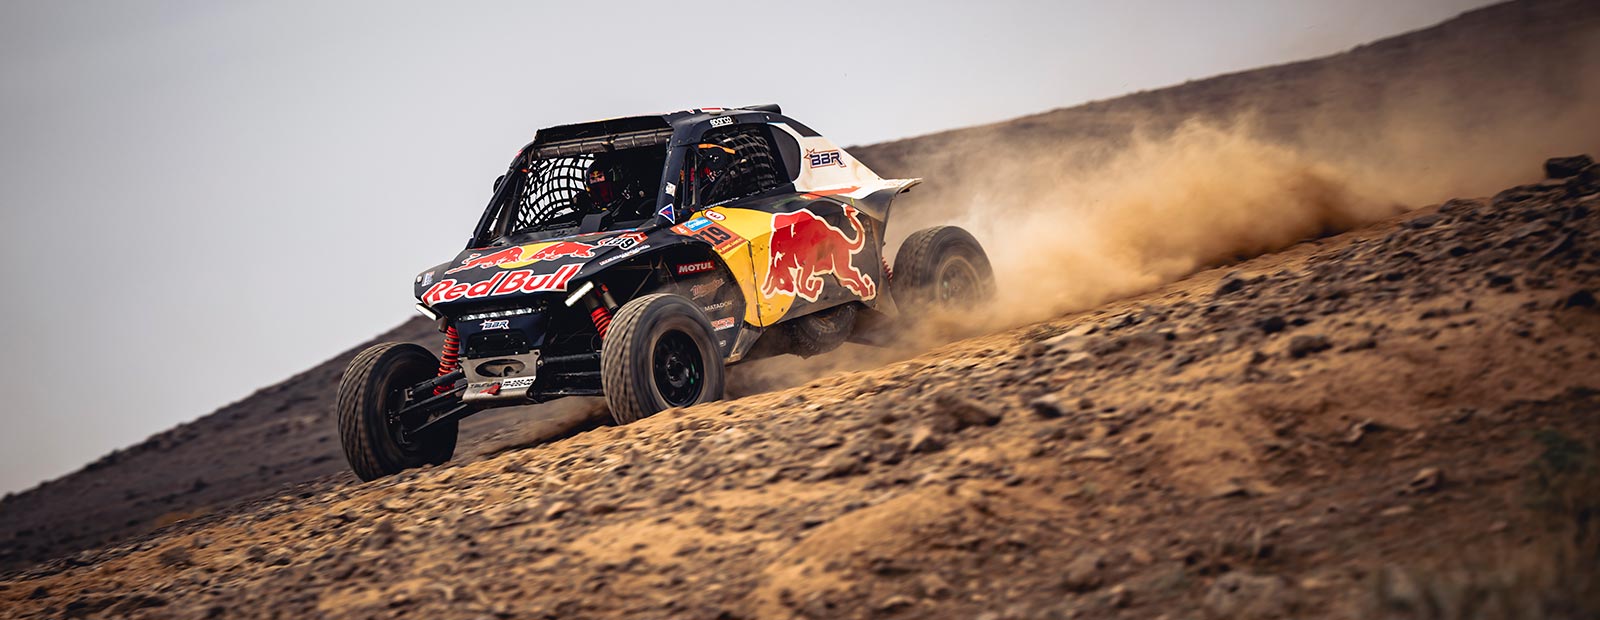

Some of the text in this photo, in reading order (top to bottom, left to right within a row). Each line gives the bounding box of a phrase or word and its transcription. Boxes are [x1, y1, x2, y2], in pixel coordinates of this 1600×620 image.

[808, 150, 845, 168] BBR
[678, 261, 714, 273] MOTUL
[421, 271, 504, 307] Red
[490, 263, 585, 296] Bull
[704, 300, 734, 312] MATADOR
[481, 319, 509, 330] BBR
